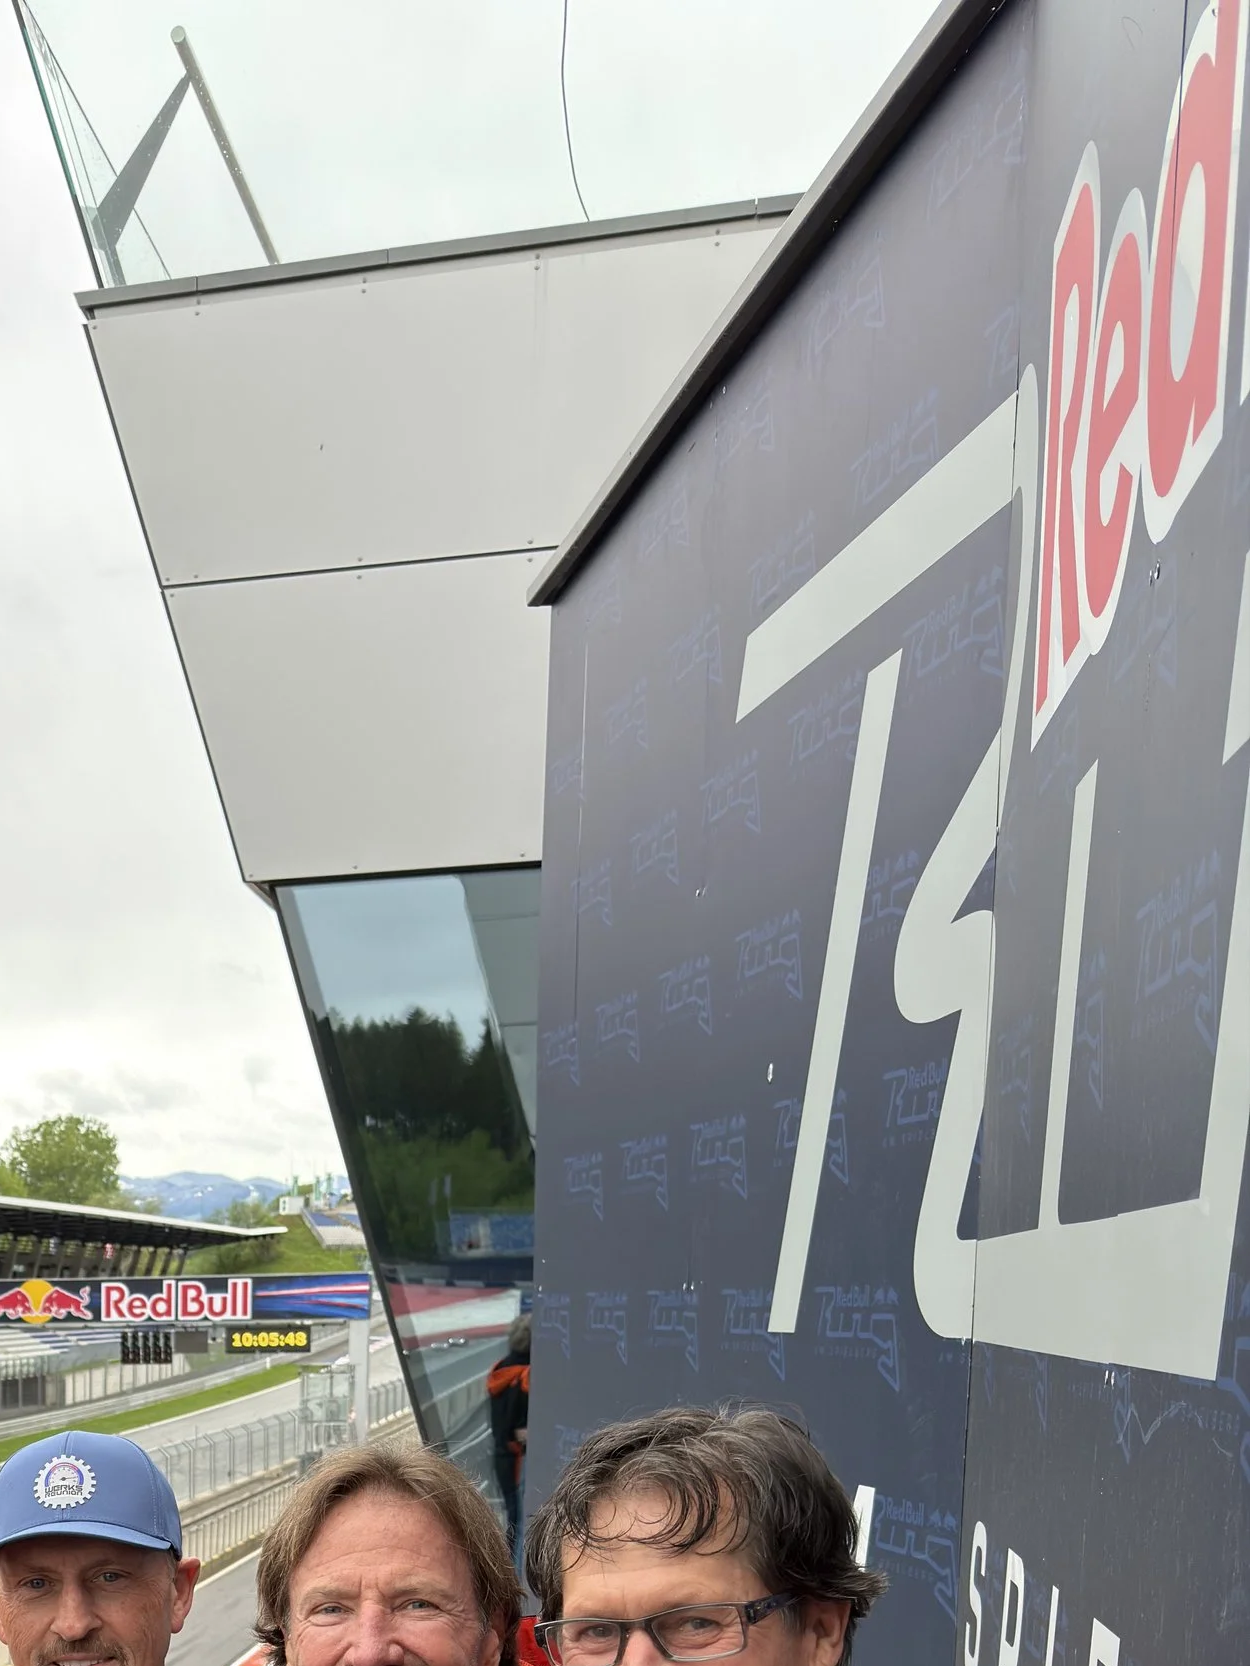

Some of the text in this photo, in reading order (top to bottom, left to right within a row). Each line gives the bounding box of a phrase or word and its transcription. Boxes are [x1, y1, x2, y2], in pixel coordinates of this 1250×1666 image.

[104, 1280, 250, 1320] Red Bull
[231, 1331, 308, 1348] 10:05:48
[45, 1485, 83, 1494] WERKS
